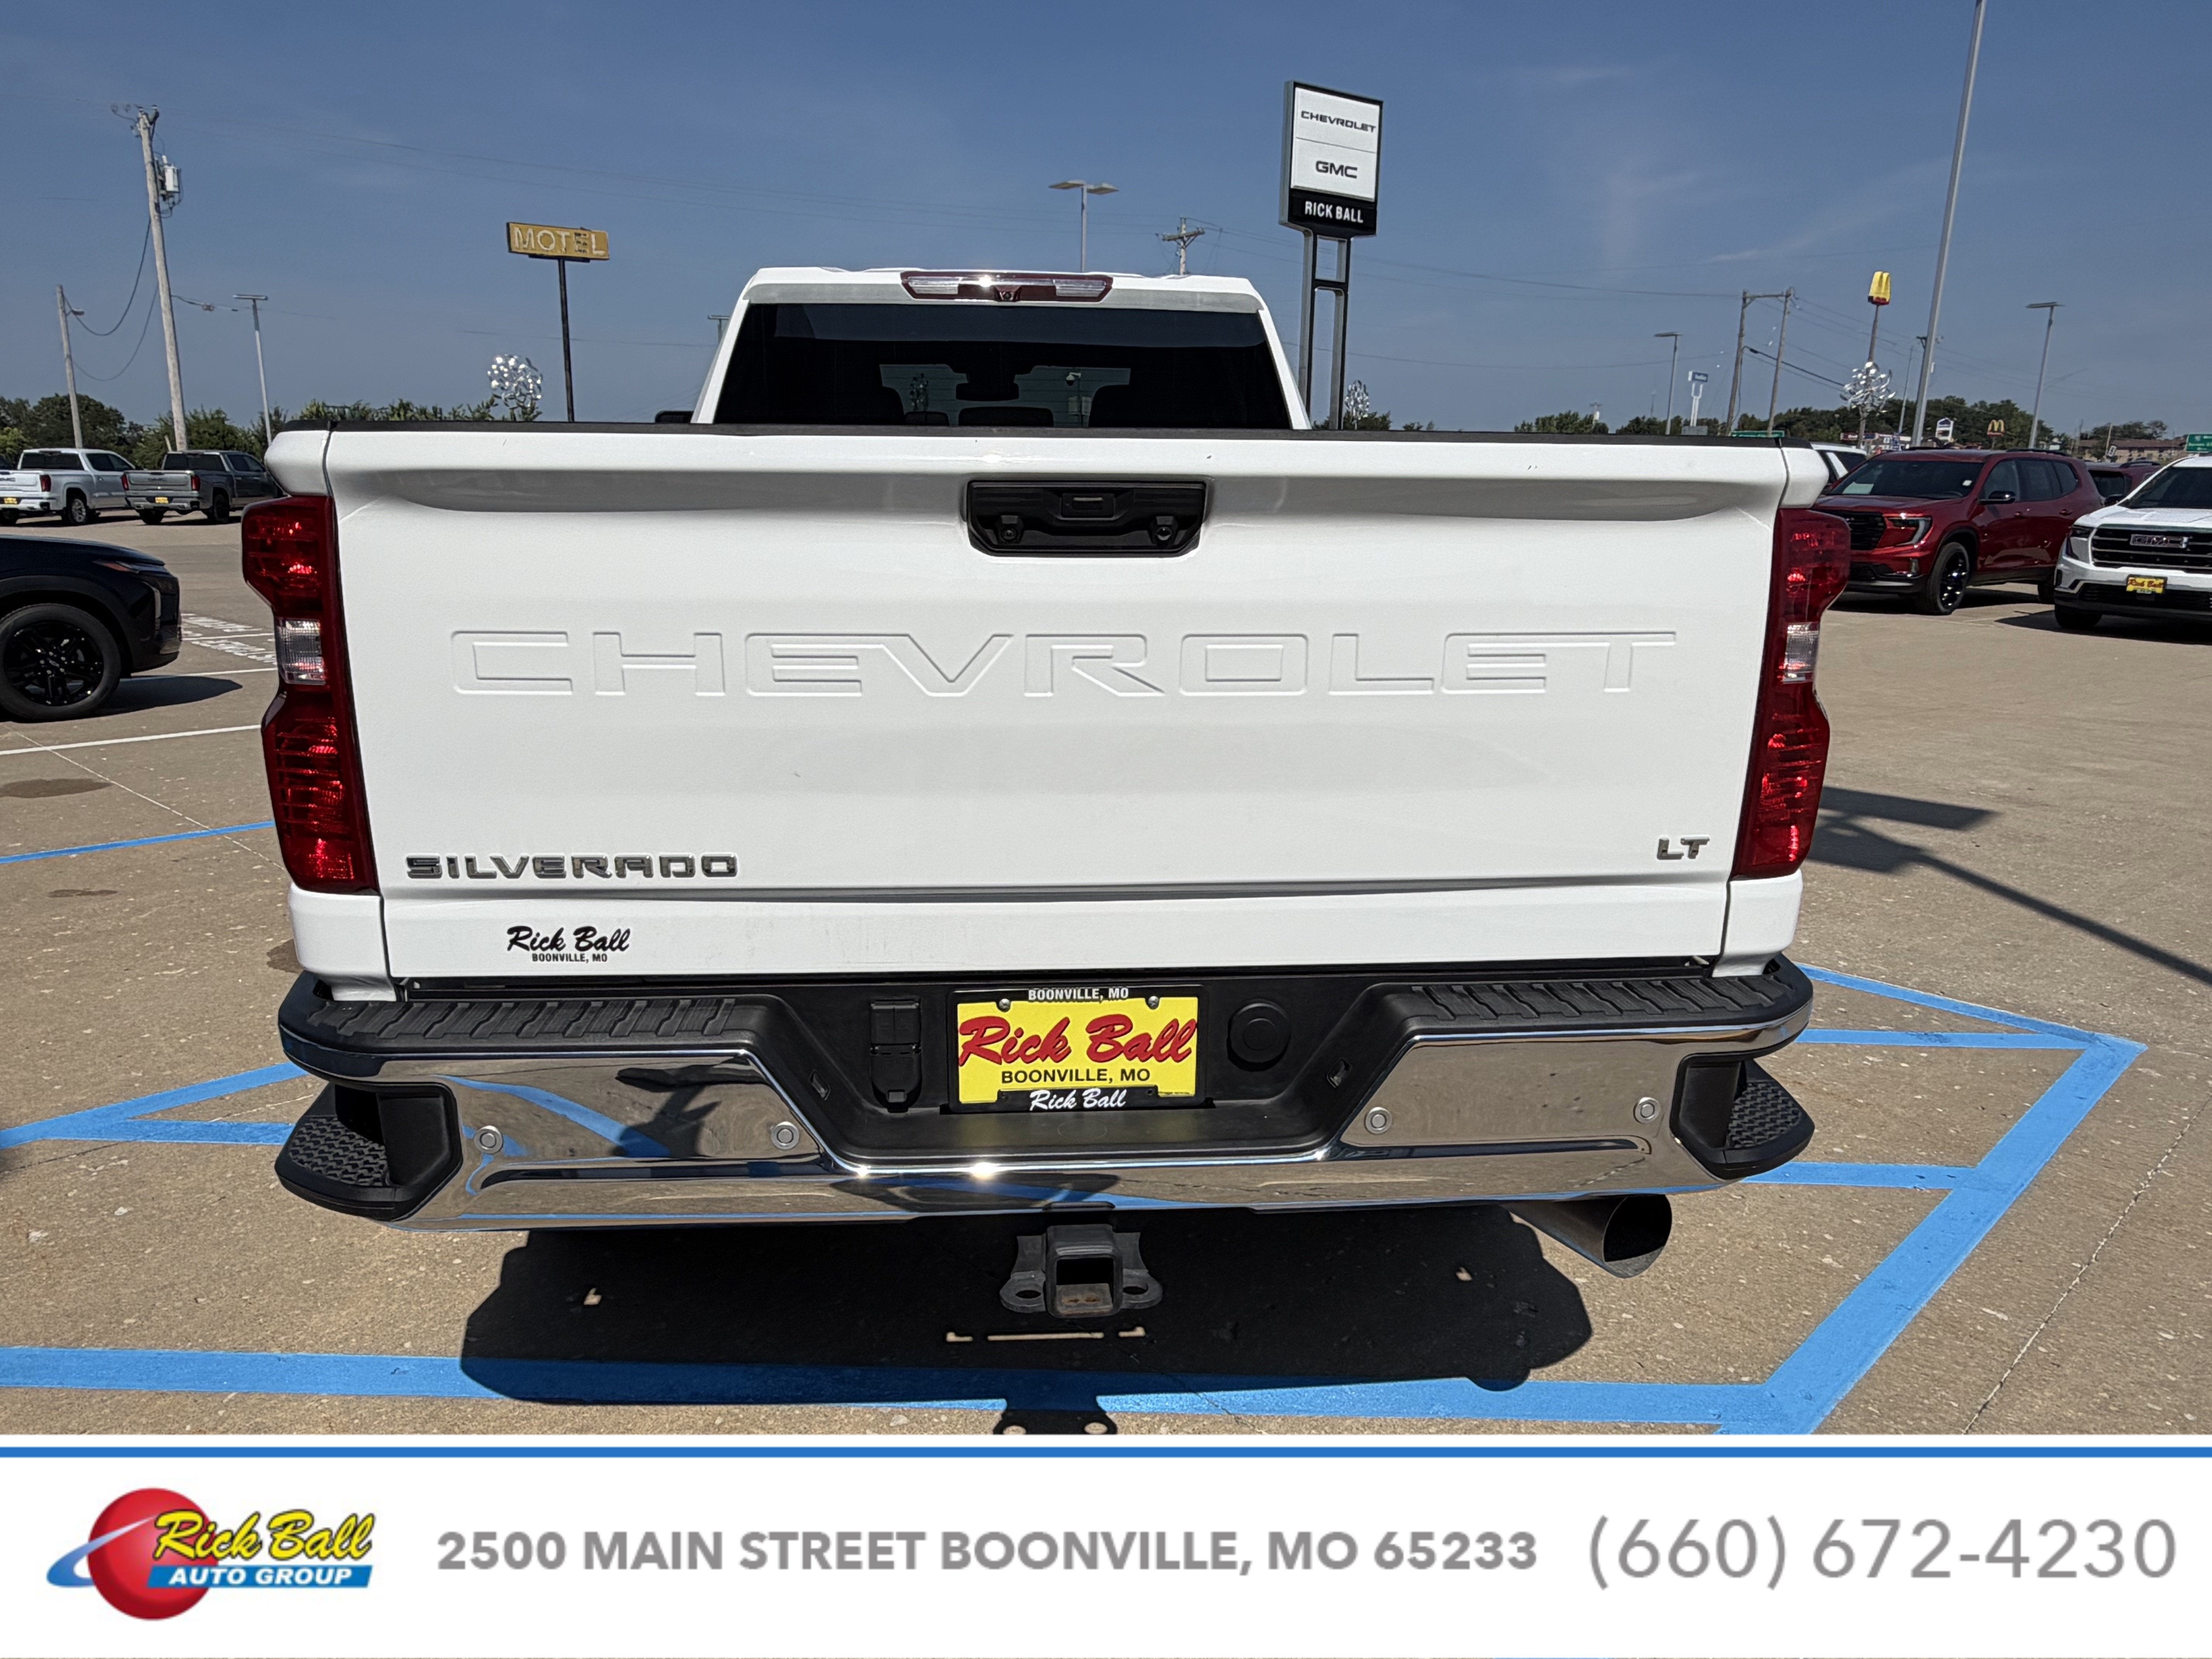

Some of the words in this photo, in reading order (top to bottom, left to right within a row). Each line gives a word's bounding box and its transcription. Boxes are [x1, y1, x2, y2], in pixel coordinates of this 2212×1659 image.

[1301, 111, 1376, 133] CHEVROLET
[1316, 161, 1357, 179] GMC
[1305, 201, 1333, 218] RICK
[1335, 206, 1363, 223] BALL
[513, 227, 605, 255] MOTEL
[452, 630, 1676, 696] CHEVROLET
[1657, 836, 1710, 860] LT
[406, 855, 738, 879] SILVERADO
[507, 926, 566, 951] Rick
[573, 926, 630, 951] Ball
[532, 953, 589, 963] BOONVILLE,
[592, 953, 608, 962] MO
[1028, 989, 1103, 1002] BOONVILLE,
[1108, 987, 1129, 999] MO
[957, 1016, 1072, 1066] Rick
[1085, 1014, 1197, 1063] Ball
[1001, 1069, 1113, 1084] BOONVILLE,
[1120, 1068, 1150, 1082] MO
[1029, 1090, 1077, 1111] Rick
[1082, 1088, 1127, 1109] Ball
